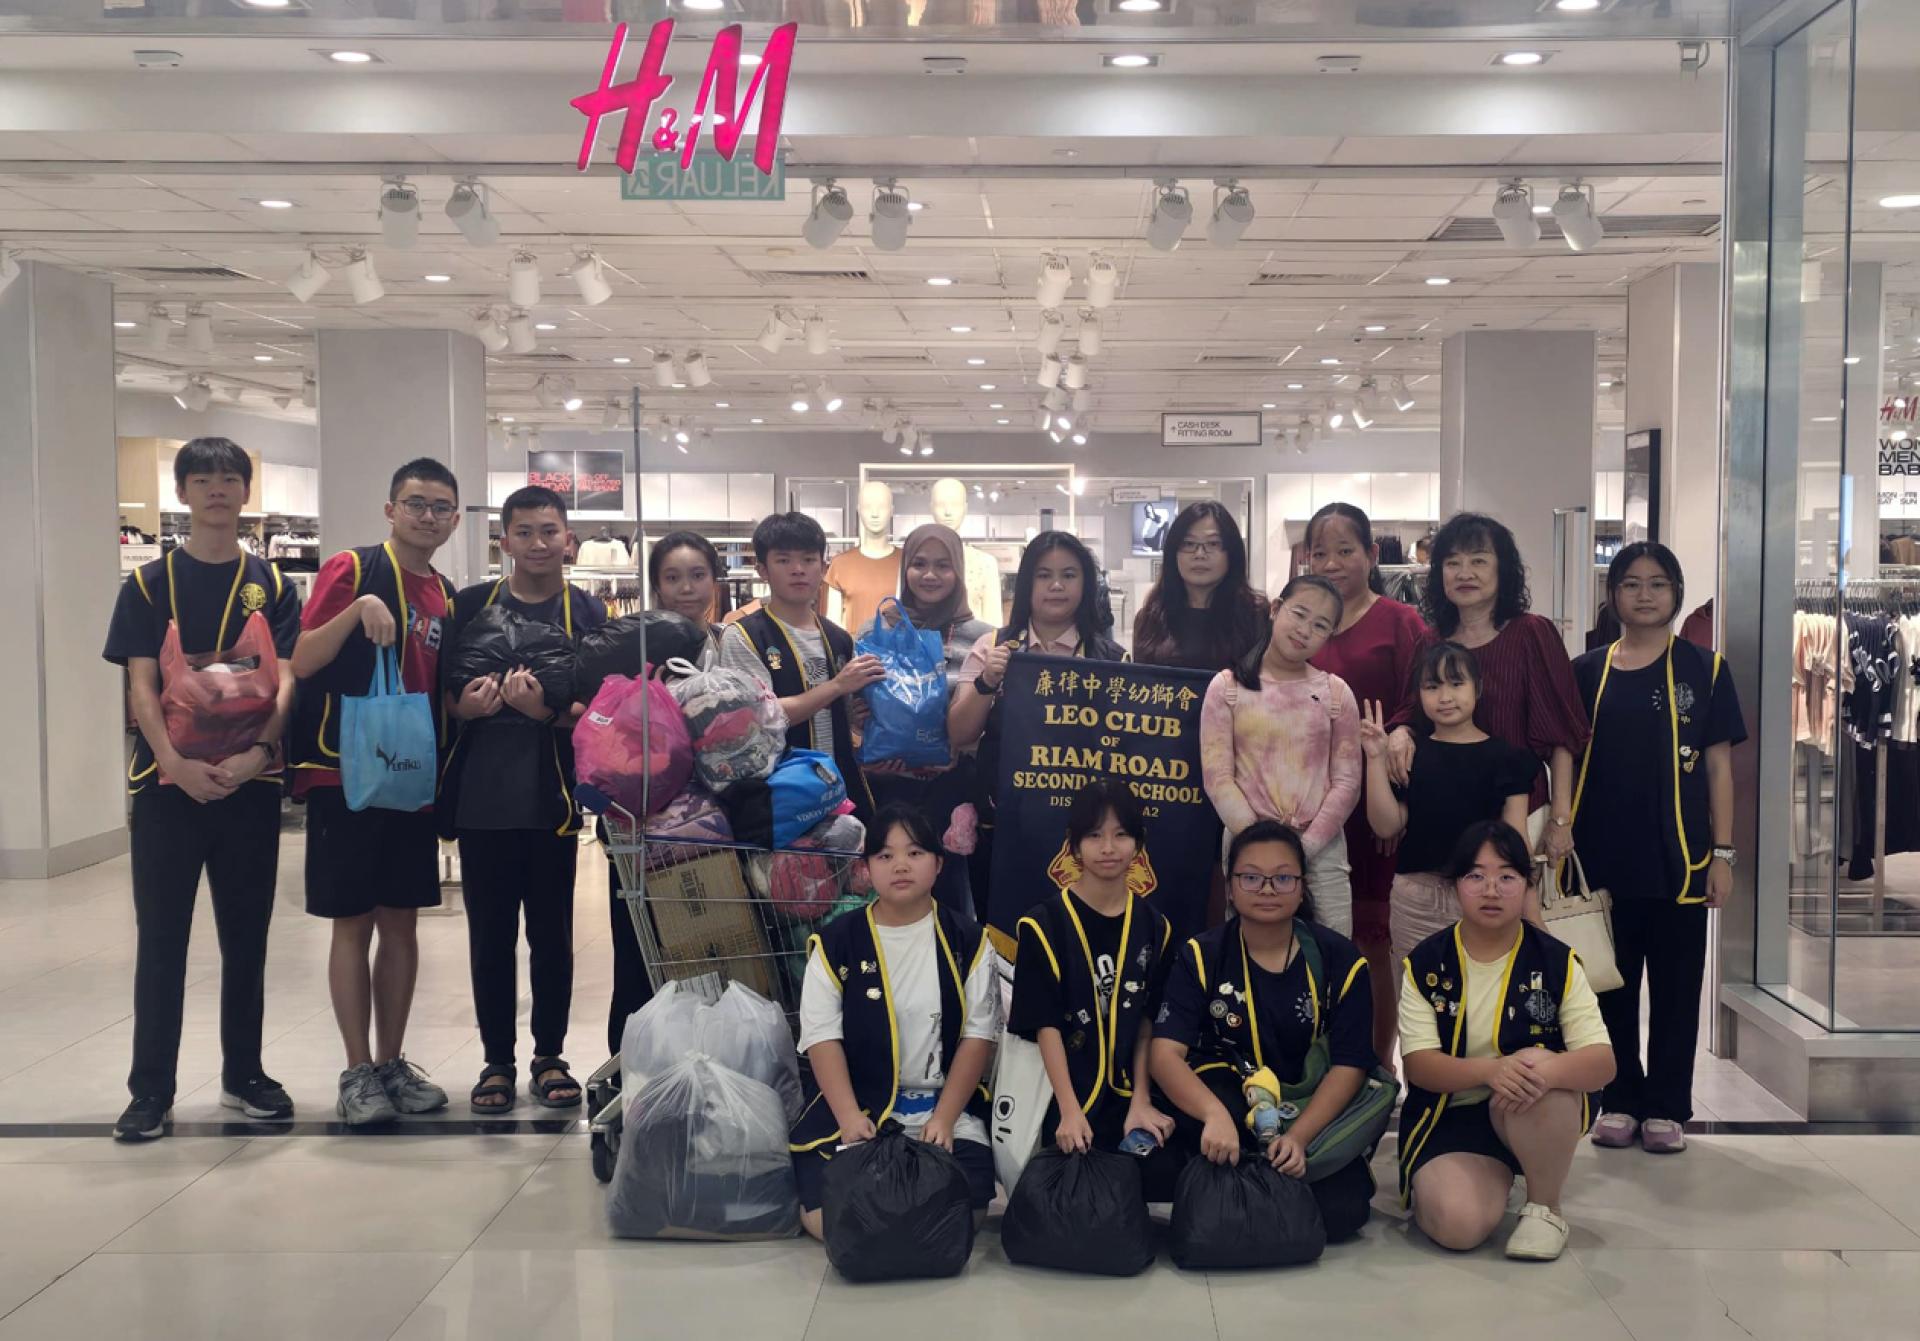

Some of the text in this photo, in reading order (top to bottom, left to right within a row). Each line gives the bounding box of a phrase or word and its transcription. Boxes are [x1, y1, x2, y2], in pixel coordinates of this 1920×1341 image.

[569, 17, 798, 175] H&M
[1177, 421, 1220, 429] CASH DESK
[1177, 429, 1232, 437] FITTING ROOM
[528, 472, 569, 483] BLACK
[1044, 704, 1182, 737] LEO CLUB
[1100, 735, 1120, 747] OF
[1030, 745, 1190, 780] RIAM ROAD
[1013, 771, 1203, 804] SECOND SCHOOL
